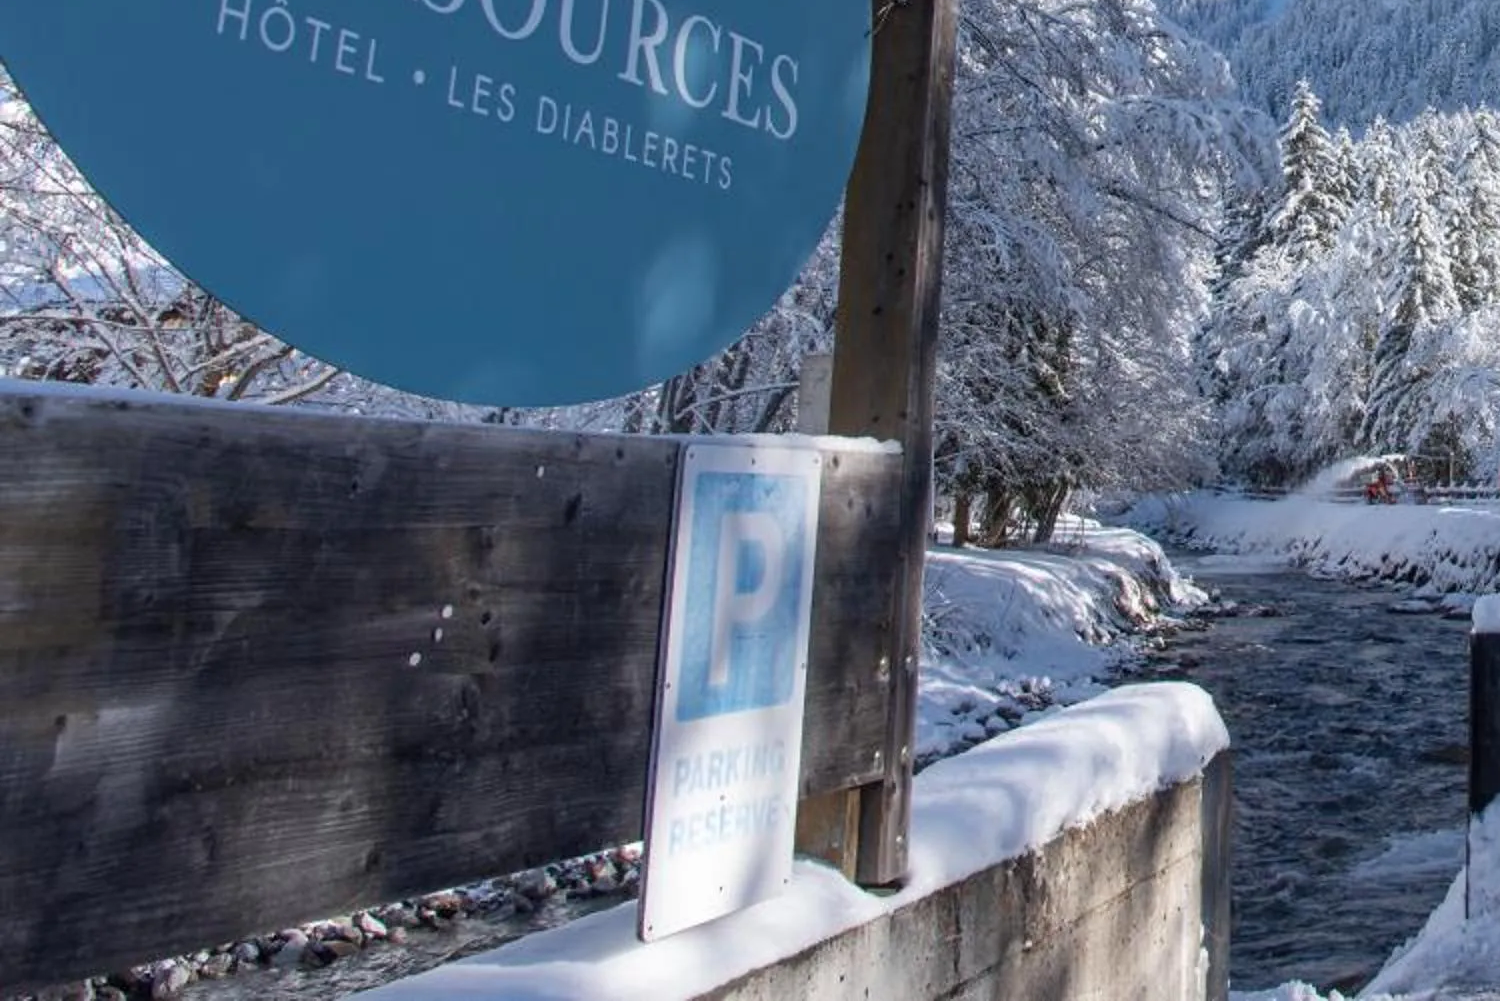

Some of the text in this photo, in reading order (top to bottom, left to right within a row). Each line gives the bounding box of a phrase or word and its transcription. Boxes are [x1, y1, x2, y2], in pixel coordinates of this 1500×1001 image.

[448, 65, 515, 123] LES
[536, 95, 733, 190] DIABLERETS
[708, 512, 784, 686] P
[673, 737, 785, 798] PARKING
